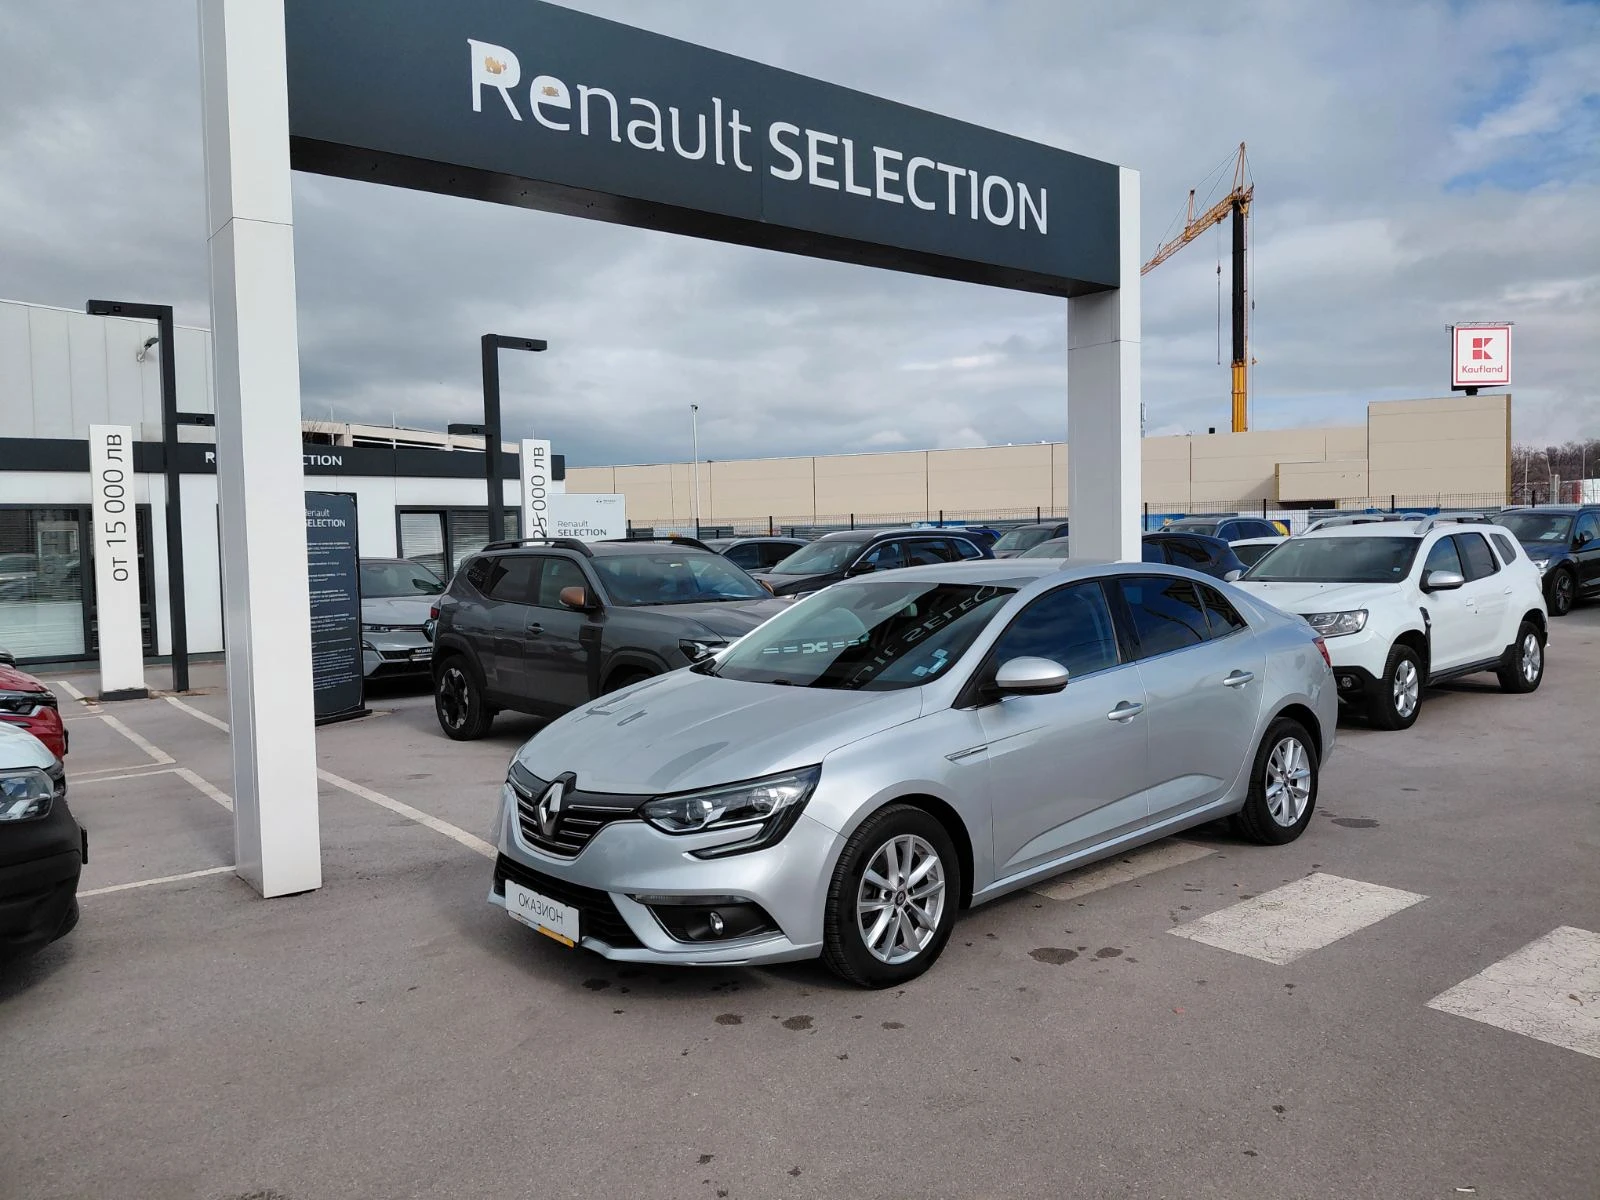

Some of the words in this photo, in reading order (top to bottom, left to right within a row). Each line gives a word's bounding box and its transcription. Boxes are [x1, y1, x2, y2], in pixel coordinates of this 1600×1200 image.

[467, 38, 752, 171] Renault
[769, 121, 1048, 234] SELECTION
[1462, 365, 1503, 374] Kaufland
[103, 469, 125, 513] 000
[531, 475, 547, 511] 000
[106, 522, 127, 547] 15
[557, 520, 588, 528] Renault
[557, 528, 607, 537] SELECTION
[518, 893, 564, 925] ОКАЗИОН
